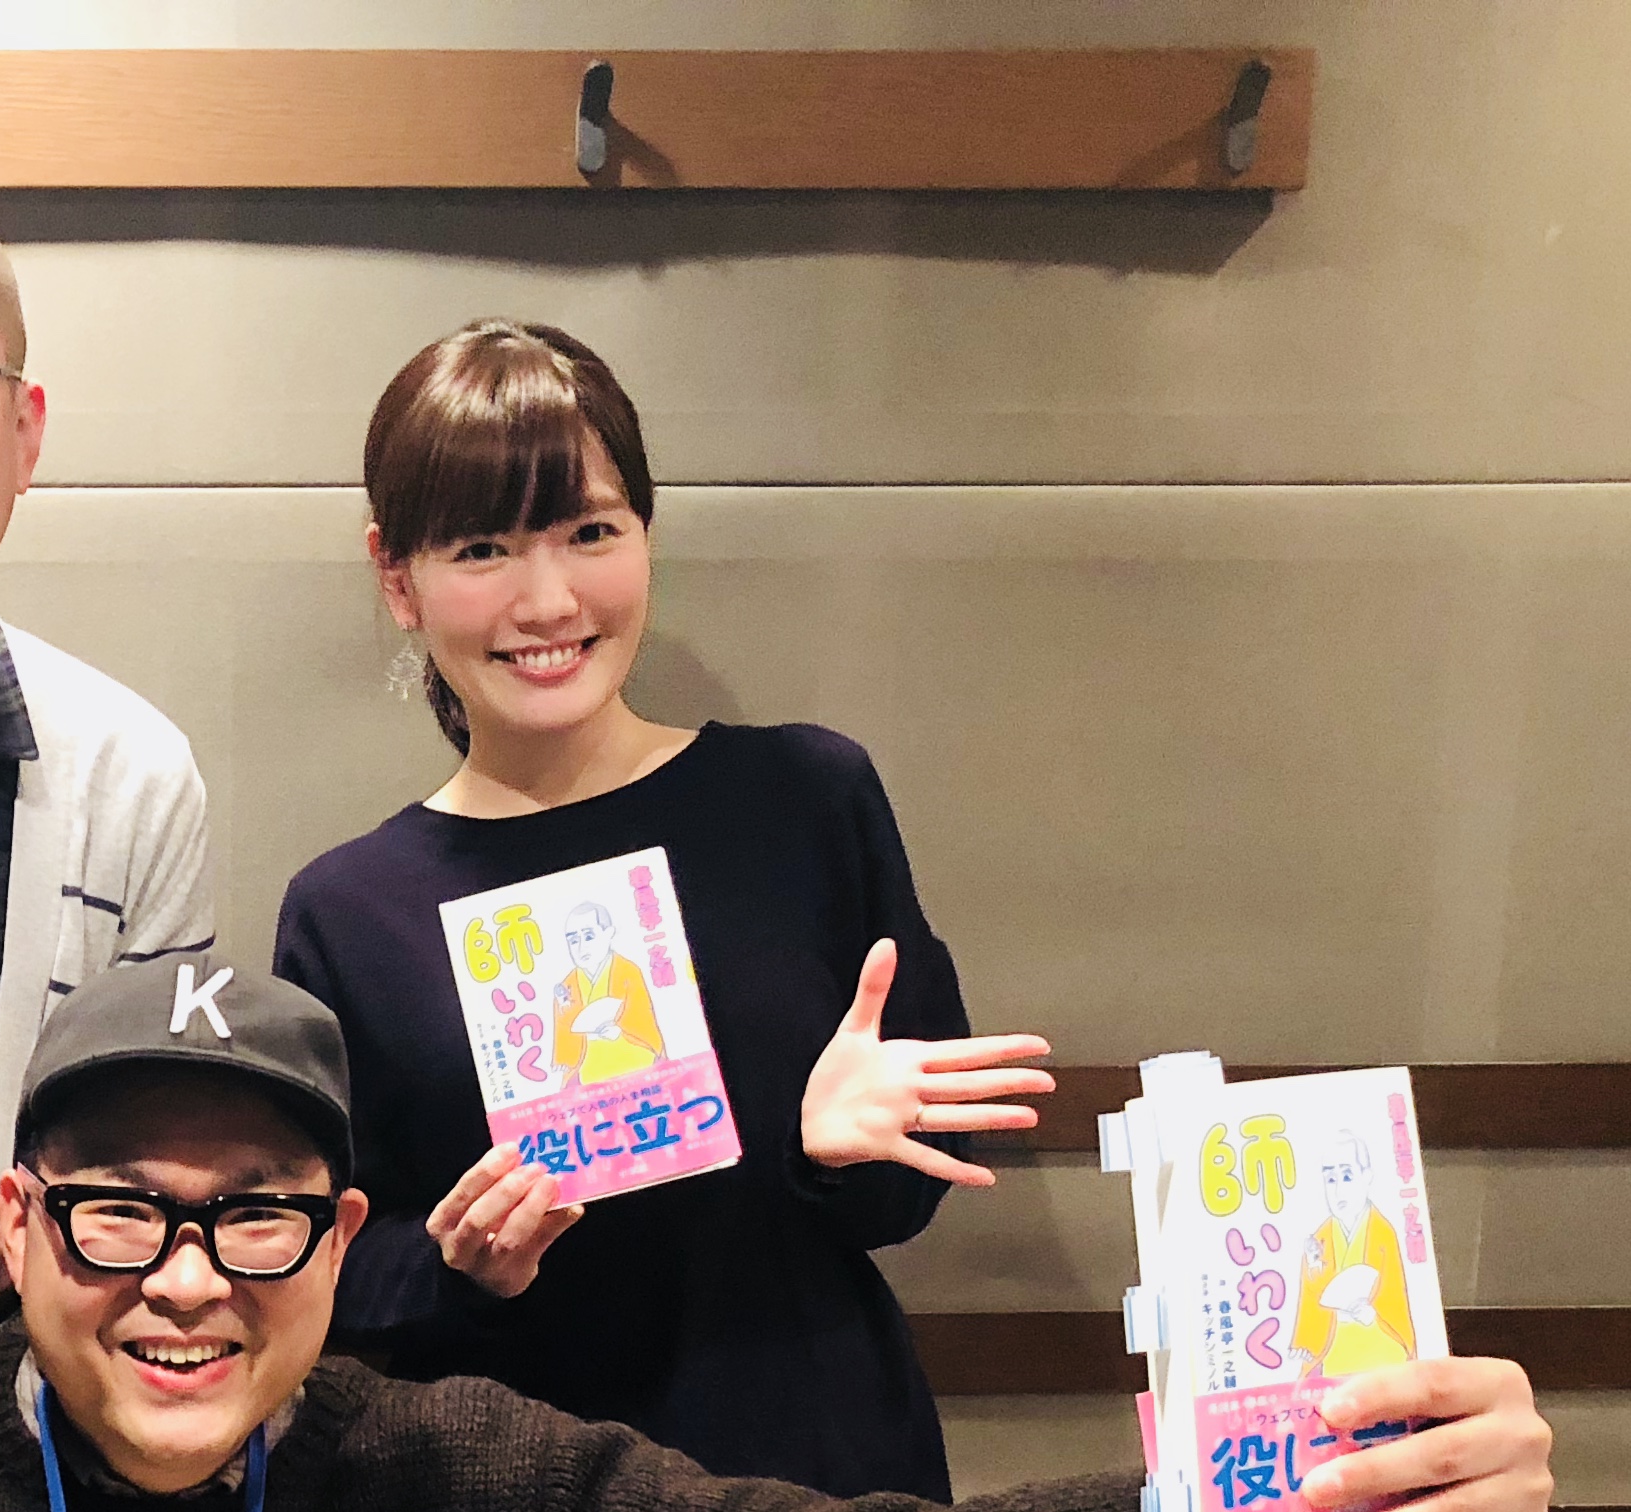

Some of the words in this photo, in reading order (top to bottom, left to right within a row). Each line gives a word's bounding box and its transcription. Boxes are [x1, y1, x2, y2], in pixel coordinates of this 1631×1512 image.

[170, 964, 234, 1038] K
[519, 1094, 724, 1176] 役に立つ
[1255, 1404, 1324, 1427] ウェブで人
